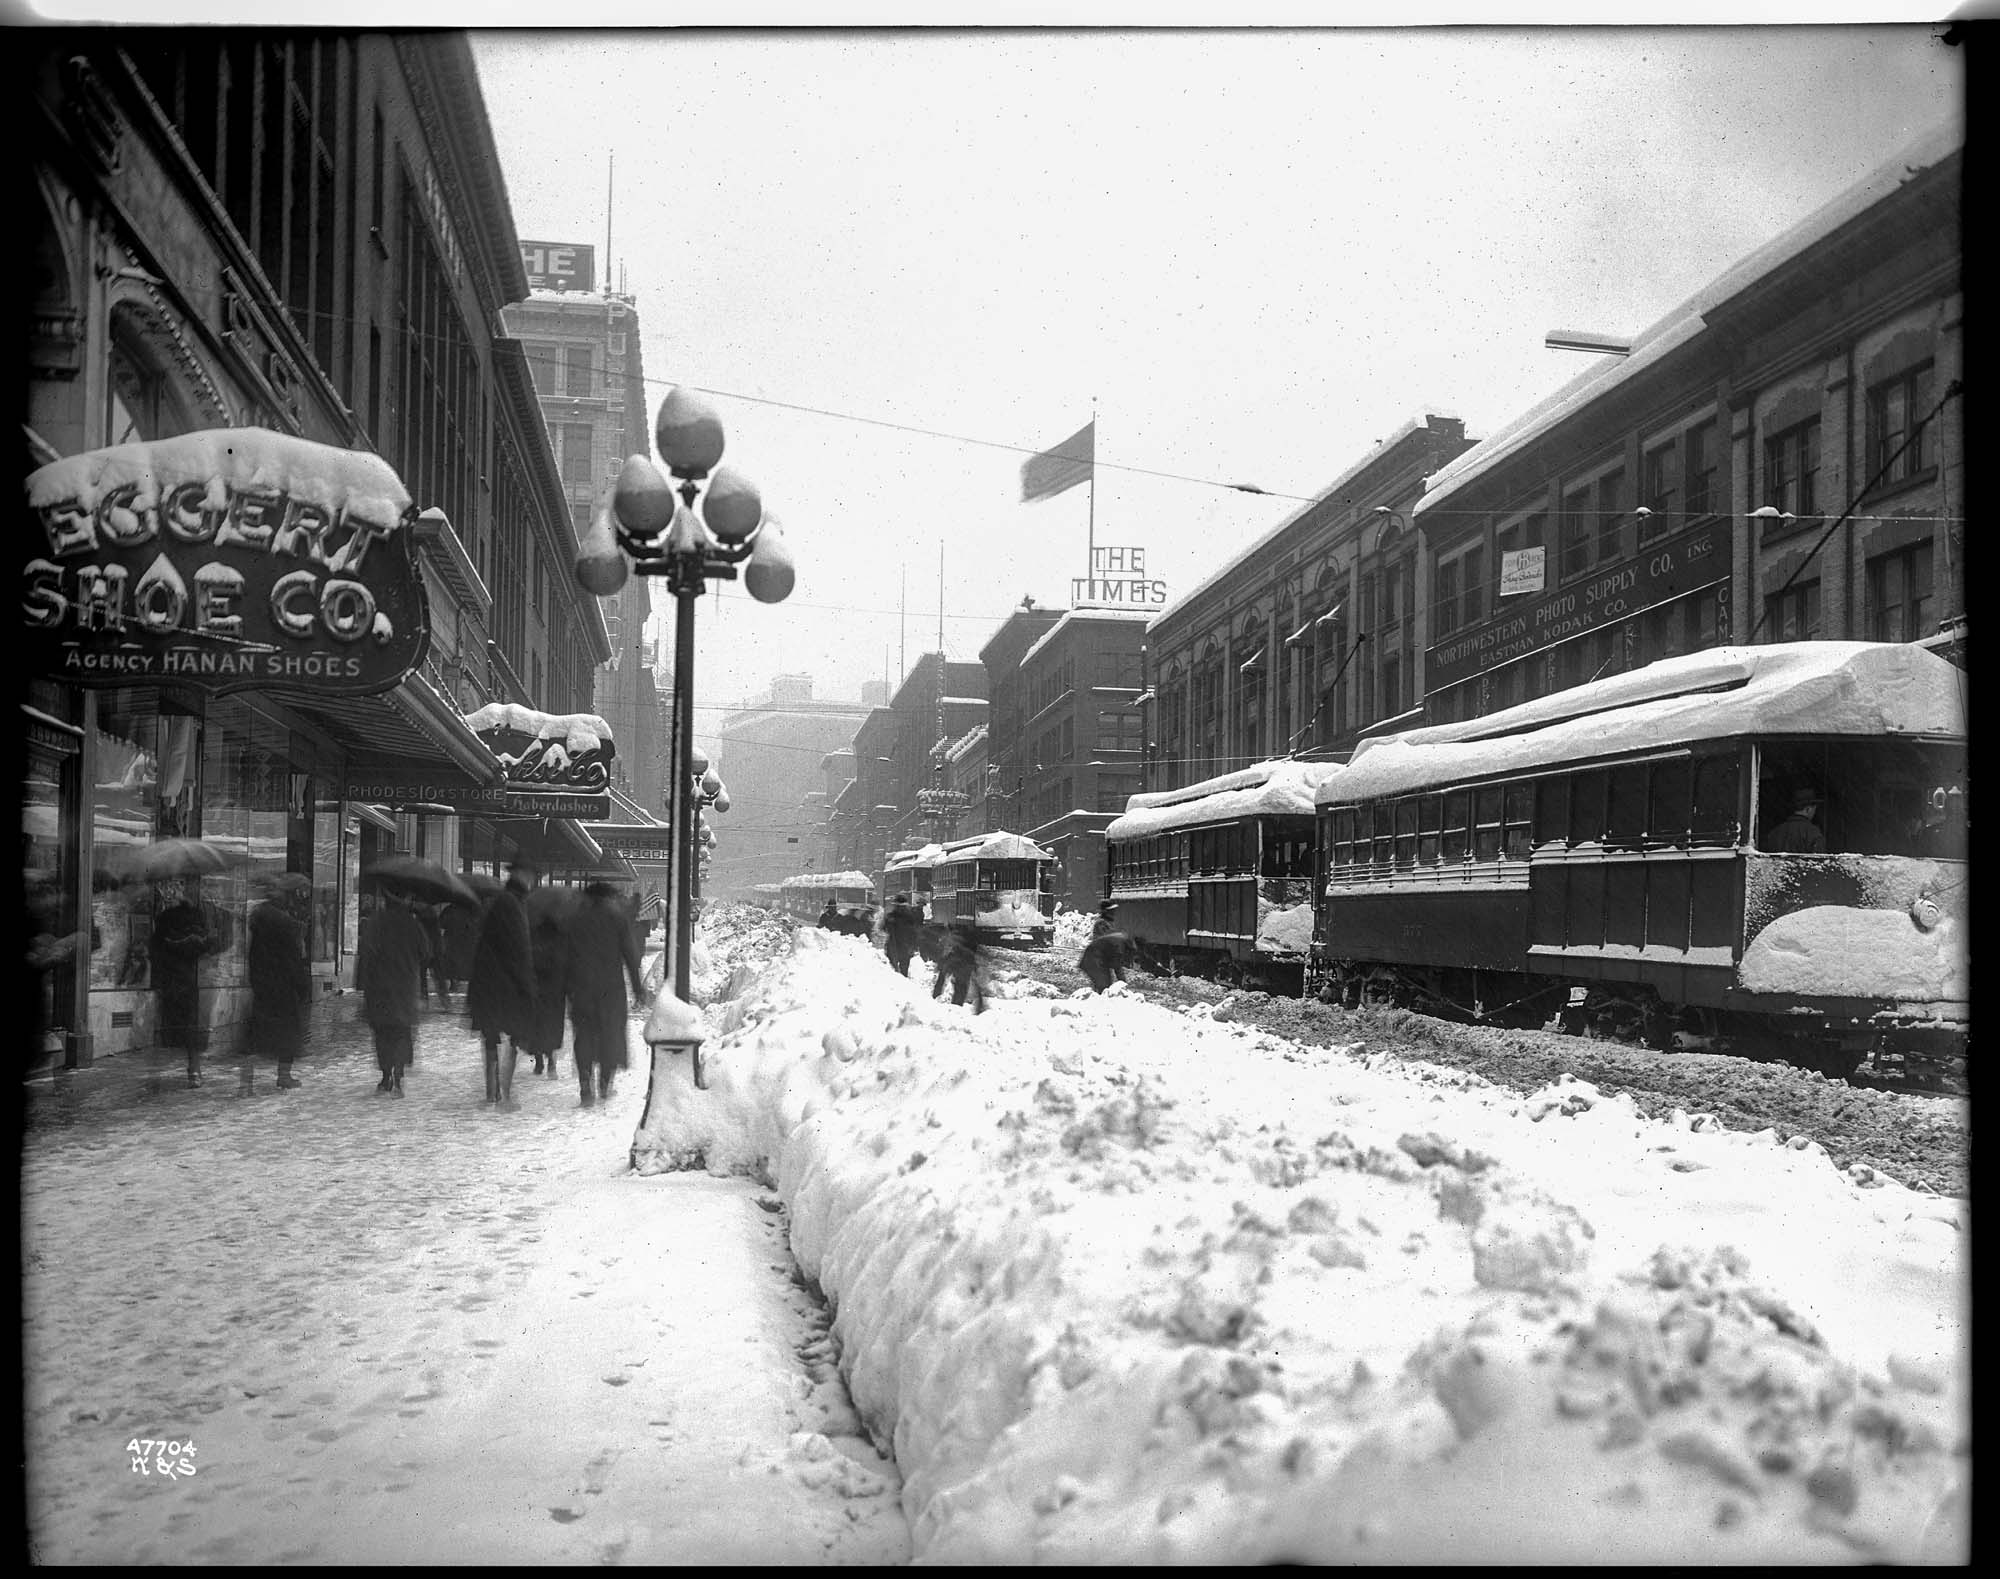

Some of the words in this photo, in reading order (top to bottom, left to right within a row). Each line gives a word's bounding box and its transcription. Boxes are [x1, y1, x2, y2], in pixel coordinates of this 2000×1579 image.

[38, 480, 399, 575] EGGERT
[1092, 547, 1144, 571] THE
[23, 557, 245, 637] SHOE
[270, 570, 393, 644] CO.
[1071, 579, 1167, 603] TIMES
[1435, 616, 1528, 668] NORTHWESTERN
[1535, 593, 1576, 626] PHOTO
[1585, 565, 1639, 604] SUPPLY
[1650, 553, 1674, 577] CO.
[1687, 539, 1712, 558] INC.
[1479, 635, 1535, 666] EASTMAN
[1543, 611, 1593, 641] KODAK
[1604, 599, 1628, 616] CO.
[1718, 587, 1728, 646] CAM
[163, 651, 255, 675] HANAN
[267, 655, 362, 677] SHOES
[348, 784, 418, 799] RHODES
[447, 788, 505, 800] STORE
[513, 797, 600, 813] Haberdashers
